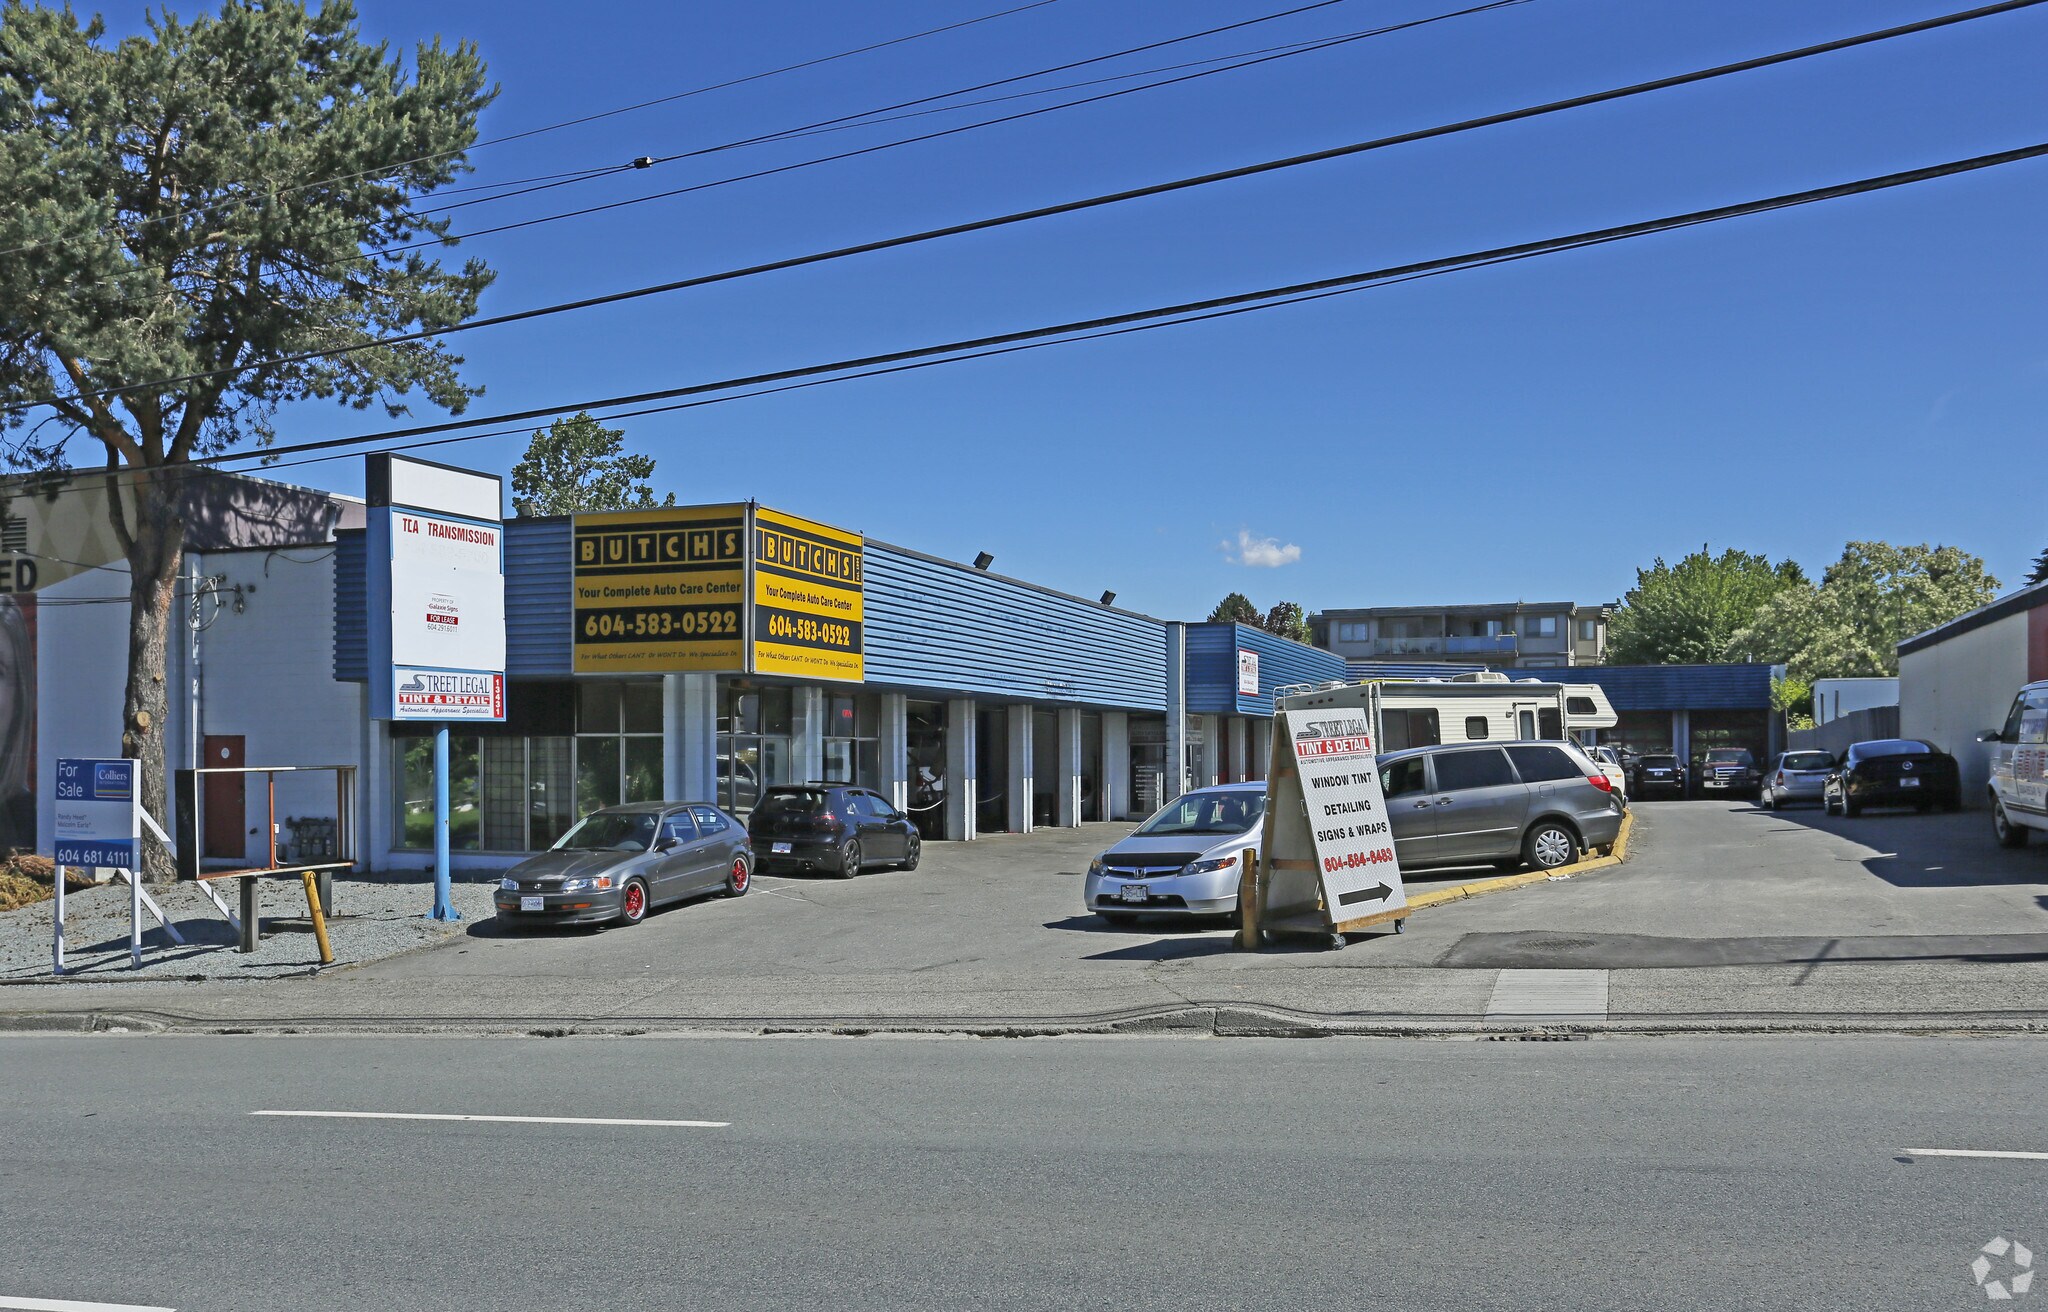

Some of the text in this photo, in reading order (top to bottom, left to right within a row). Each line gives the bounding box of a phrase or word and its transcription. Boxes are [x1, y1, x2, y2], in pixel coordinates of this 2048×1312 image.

[402, 518, 494, 546] TCA TRANSMISSION
[582, 533, 736, 562] BUTCHS
[768, 536, 850, 576] BUTCHS
[578, 582, 741, 599] Your Complete Auto Care Center
[766, 584, 852, 610] Your Complete Auto Care Center
[447, 605, 459, 613] Signs
[441, 616, 456, 624] LEASE
[585, 610, 737, 636] 604-583-0522
[768, 614, 850, 646] 604-583-0522
[699, 650, 728, 660] Specialize
[766, 651, 777, 660] What
[460, 677, 490, 694] LEGAL
[400, 694, 488, 704] TINT & DETAIL
[431, 706, 460, 714] Appearance
[462, 706, 489, 714] Specialists
[1344, 719, 1368, 736] LEGAL
[1299, 738, 1369, 755] TINT & DETAIL
[58, 762, 78, 777] For
[98, 769, 128, 780] Colliers
[1311, 772, 1372, 789] WINDOW TINT
[58, 782, 82, 797] Sale
[1324, 800, 1372, 816] DETAILING
[1317, 822, 1388, 842] SIGNS & WRAPS
[58, 849, 129, 865] 604 681 4111
